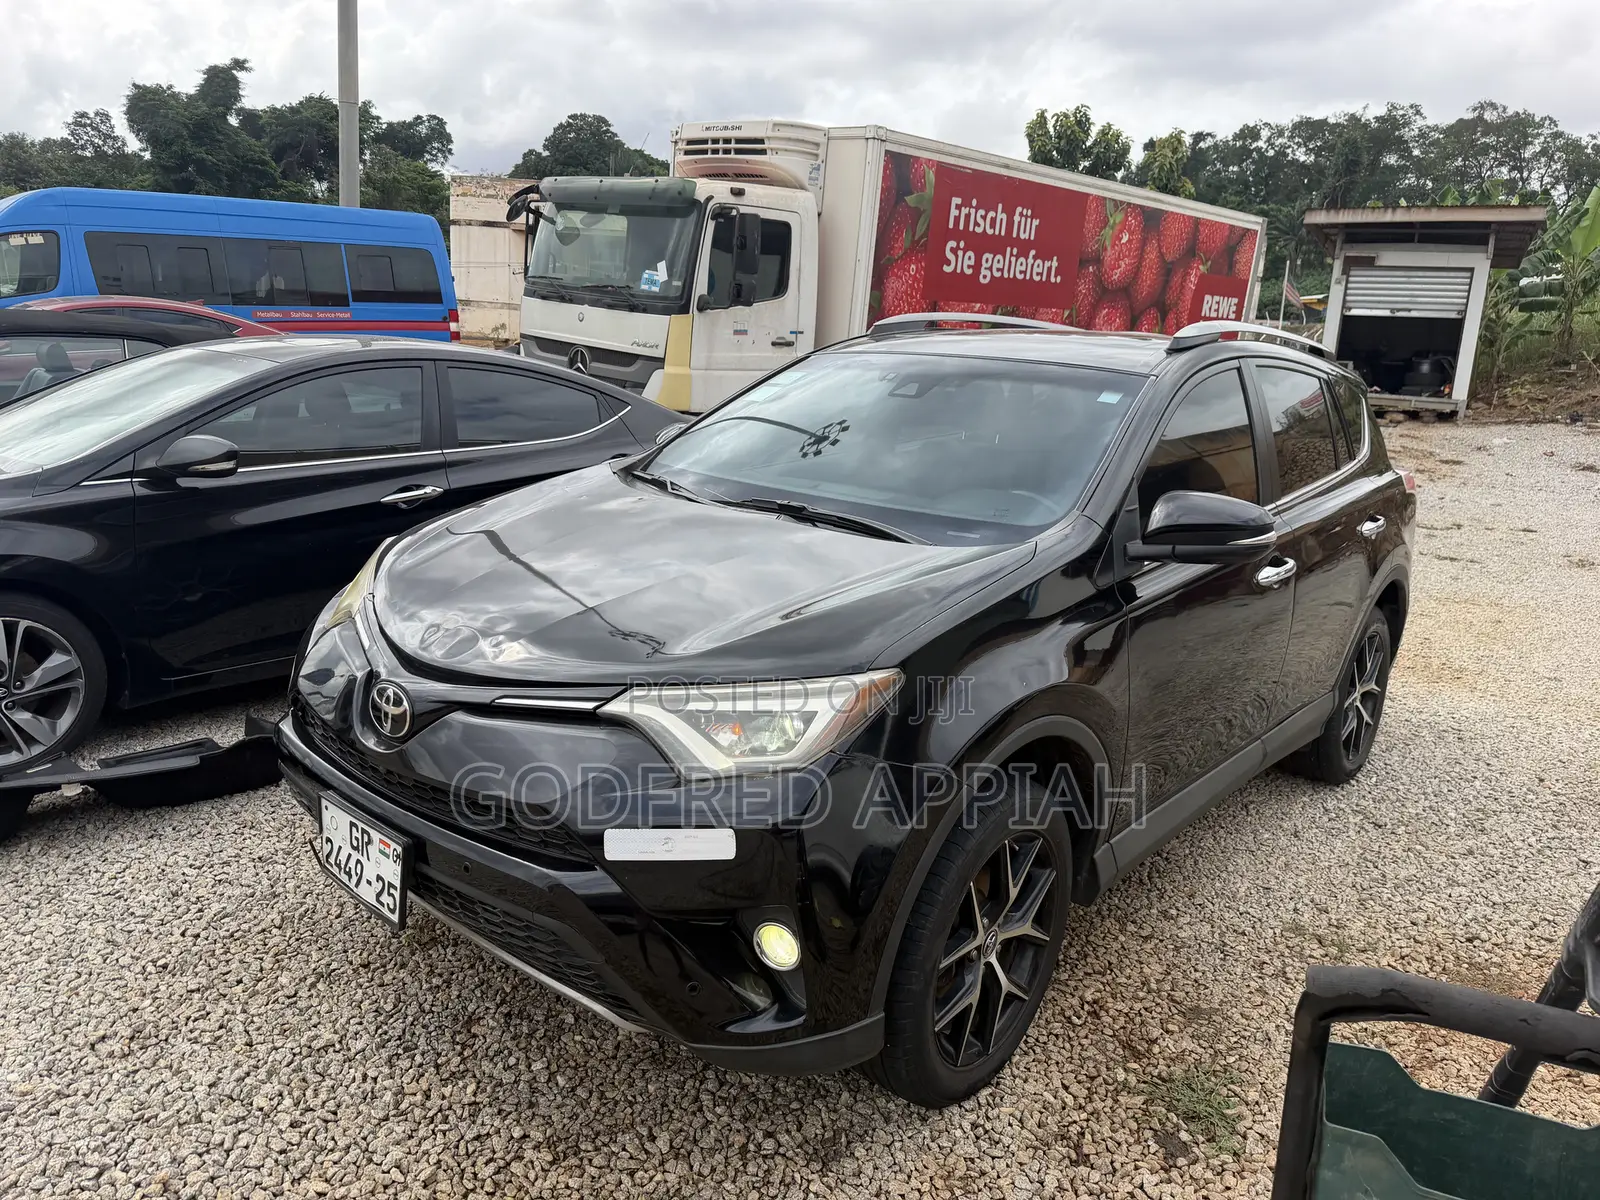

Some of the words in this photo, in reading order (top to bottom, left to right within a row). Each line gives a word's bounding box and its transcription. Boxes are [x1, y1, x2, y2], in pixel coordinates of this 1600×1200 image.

[948, 197, 1007, 236] Frisch
[1012, 206, 1040, 241] für
[942, 240, 975, 275] Sie
[979, 246, 1062, 284] geliefert.
[1201, 294, 1239, 320] REWE
[349, 820, 370, 862] GR
[325, 836, 398, 915] 2449-25
